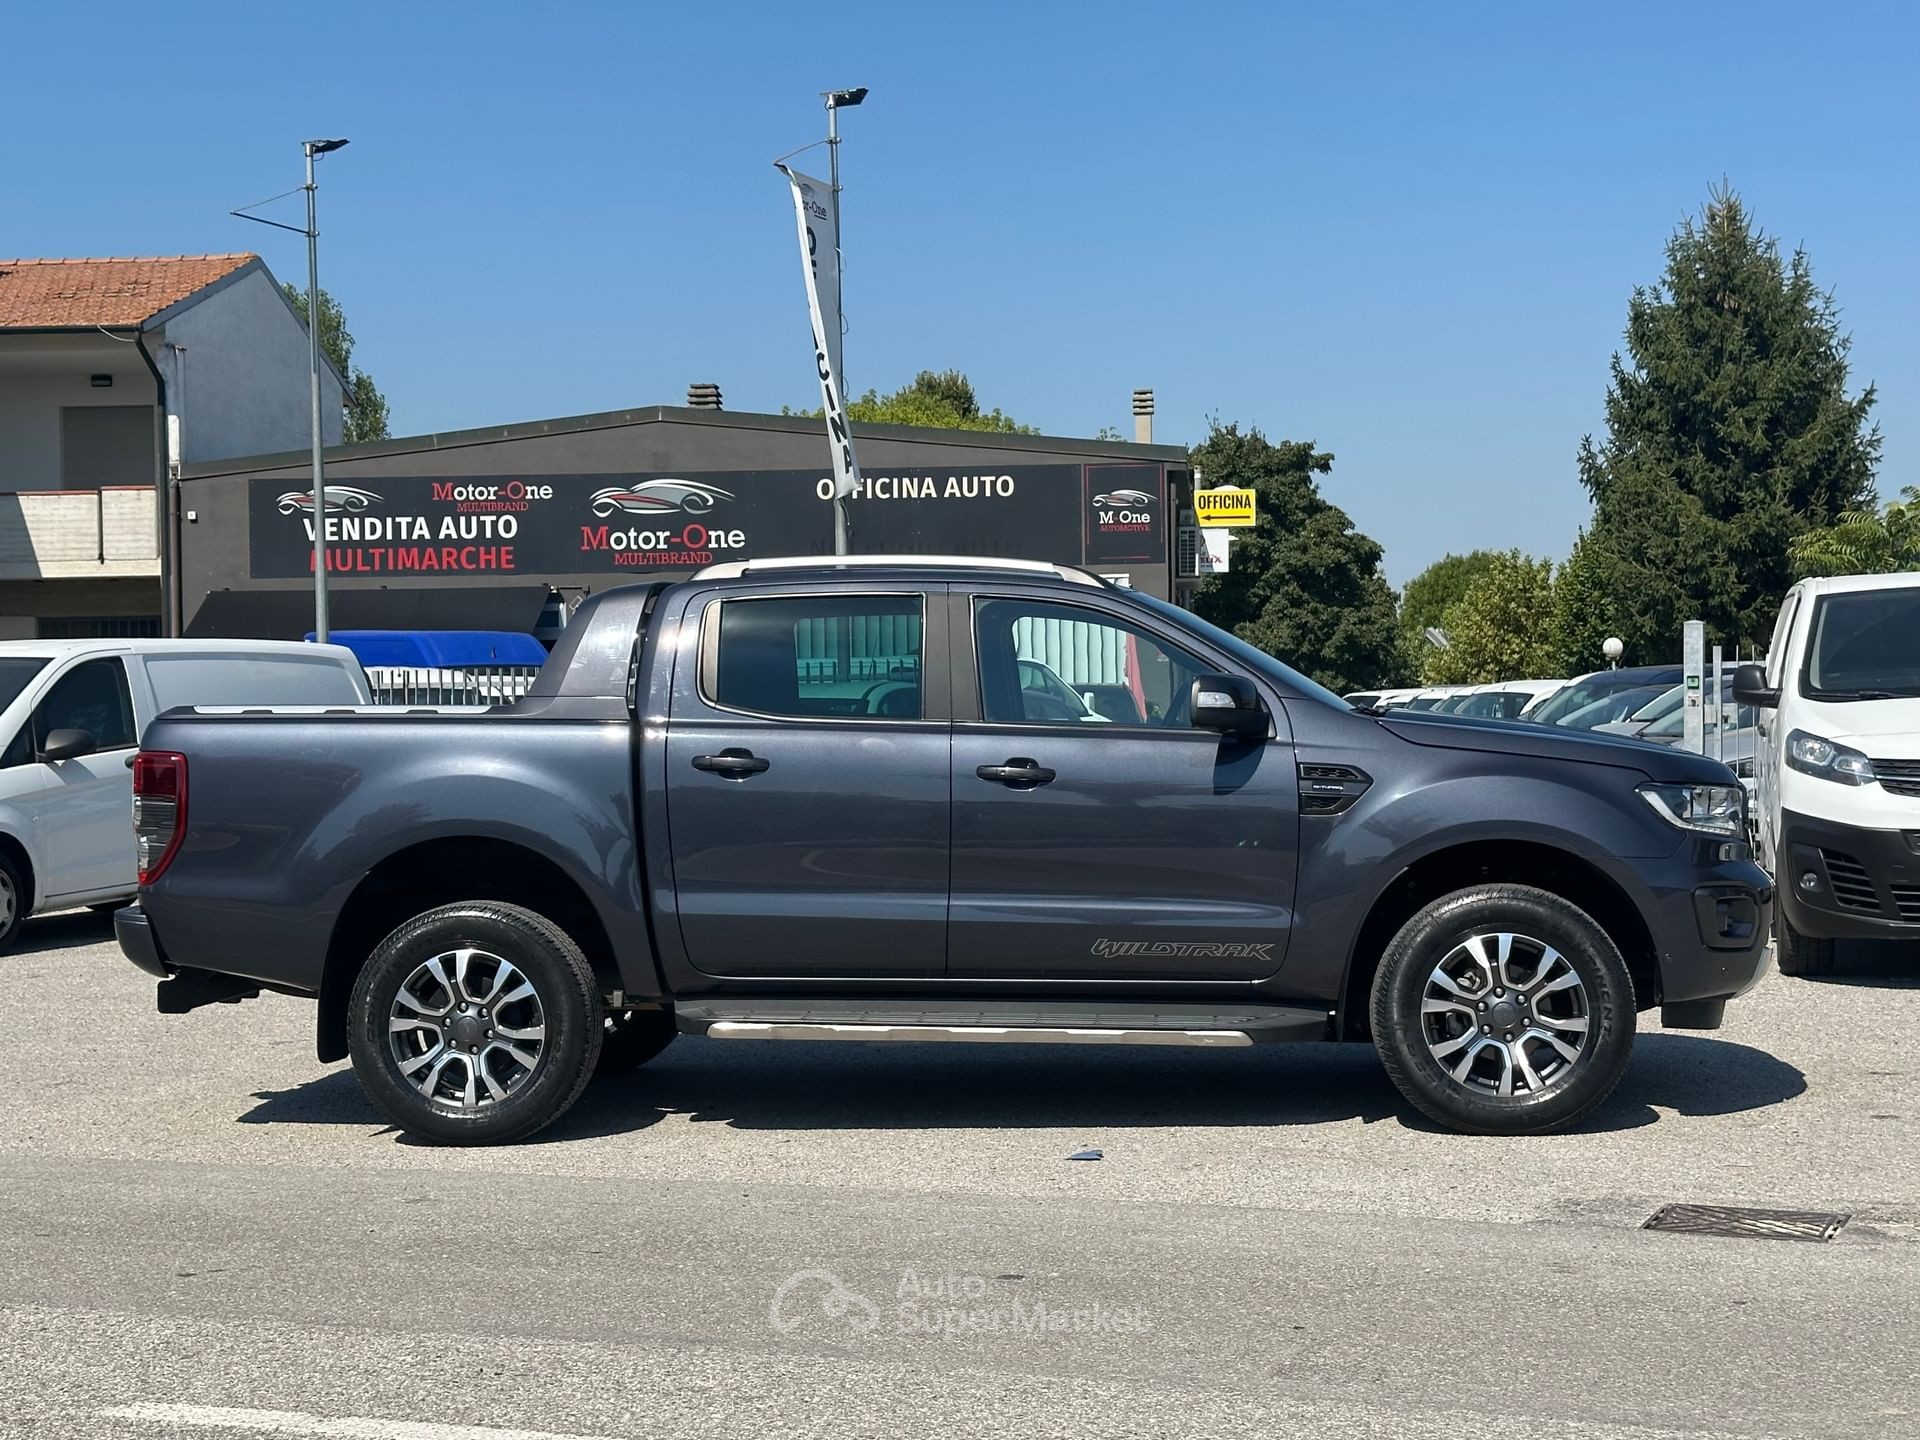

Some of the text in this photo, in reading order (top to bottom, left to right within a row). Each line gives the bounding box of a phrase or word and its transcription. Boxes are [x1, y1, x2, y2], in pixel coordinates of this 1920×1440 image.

[432, 480, 553, 501] Motor-One
[944, 475, 1015, 498] AUTO
[457, 501, 529, 513] MULTIBRAND
[1198, 494, 1252, 510] OFFICINA
[303, 514, 519, 541] VENDITA AUTO
[580, 523, 746, 551] Motor-One
[310, 546, 515, 572] MULTIMARCHE
[615, 551, 713, 566] MULTIBRAND
[1090, 938, 1275, 961] WILDTRAK
